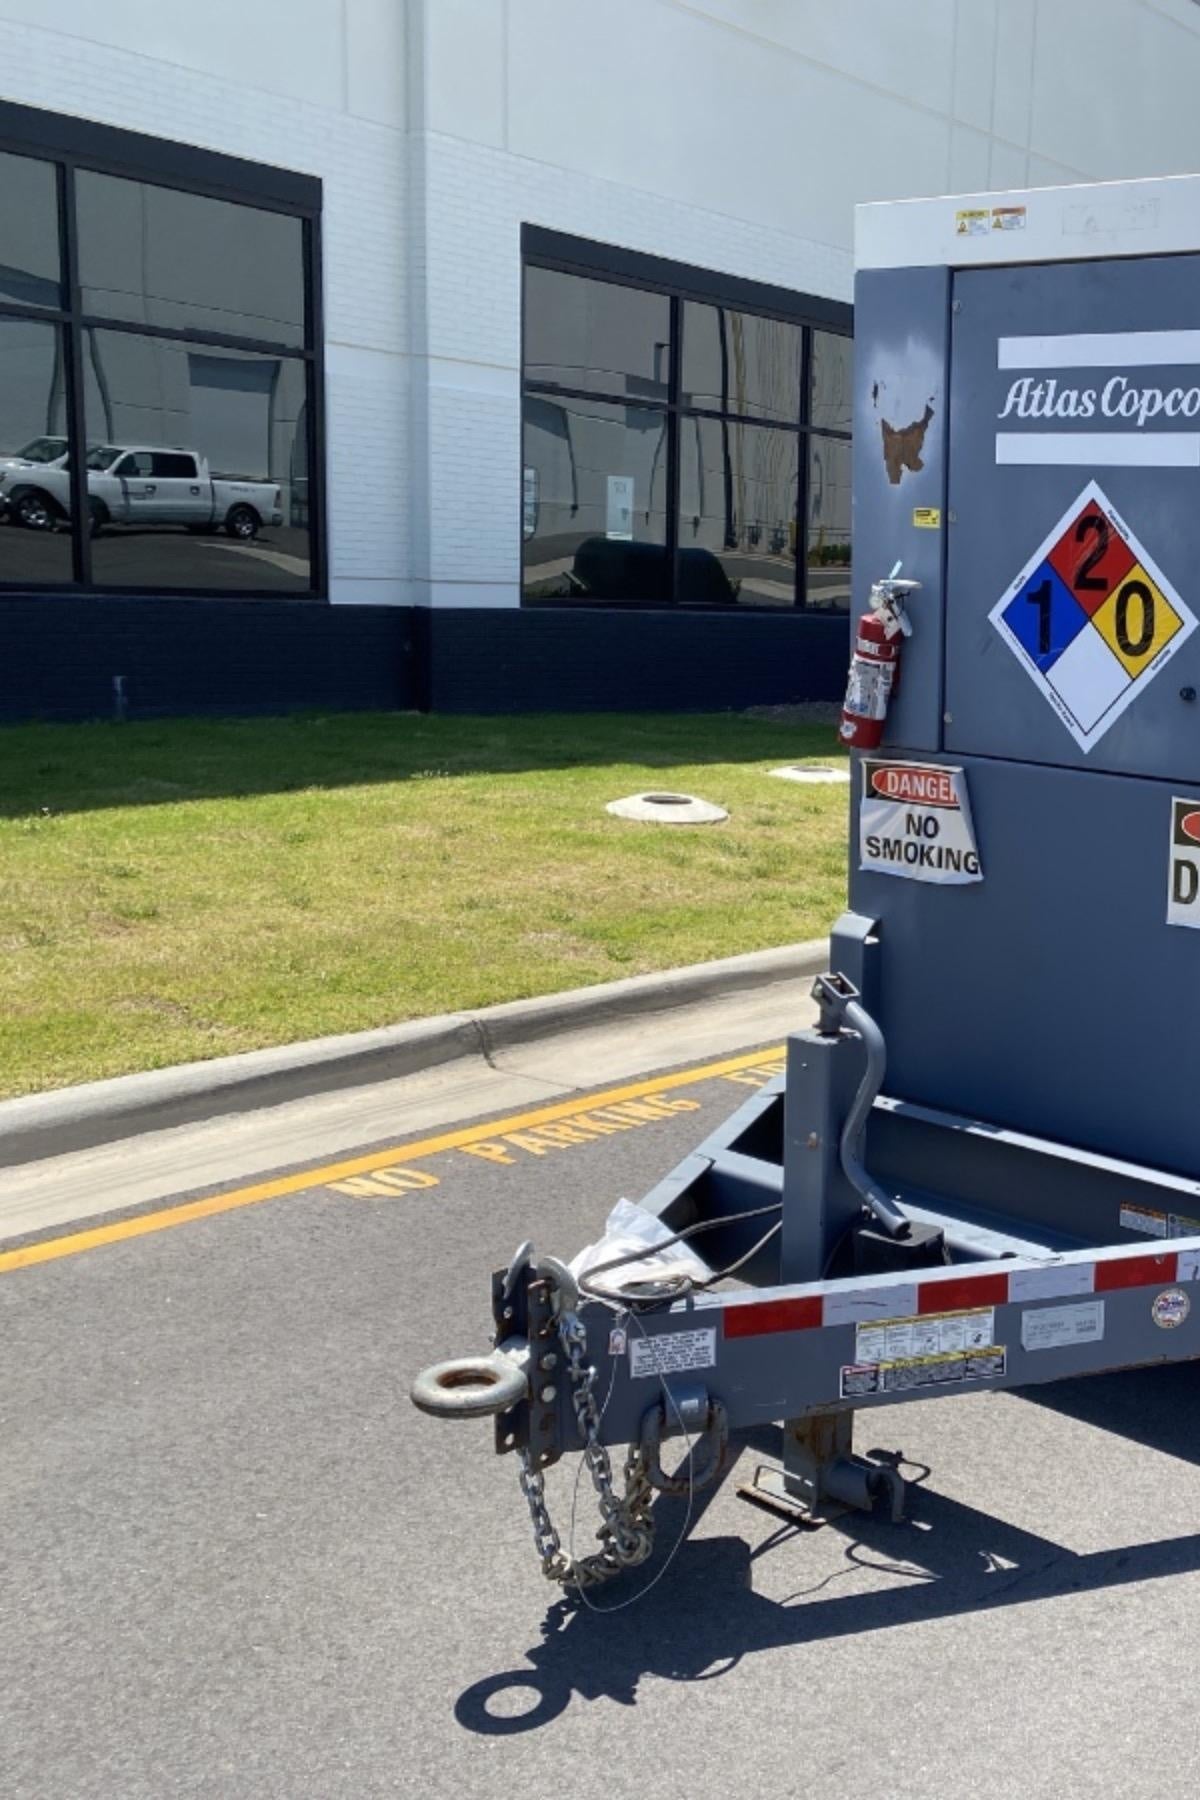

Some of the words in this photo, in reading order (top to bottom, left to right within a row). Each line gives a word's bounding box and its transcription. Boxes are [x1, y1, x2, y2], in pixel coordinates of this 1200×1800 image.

[997, 377, 1097, 418] Atlas
[1074, 515, 1109, 591] 2
[1026, 580, 1053, 655] 1
[1115, 580, 1155, 657] 0
[866, 836, 979, 874] SMOKING
[906, 814, 939, 838] NO
[324, 1168, 441, 1198] NO
[458, 1094, 701, 1164] PARKING
